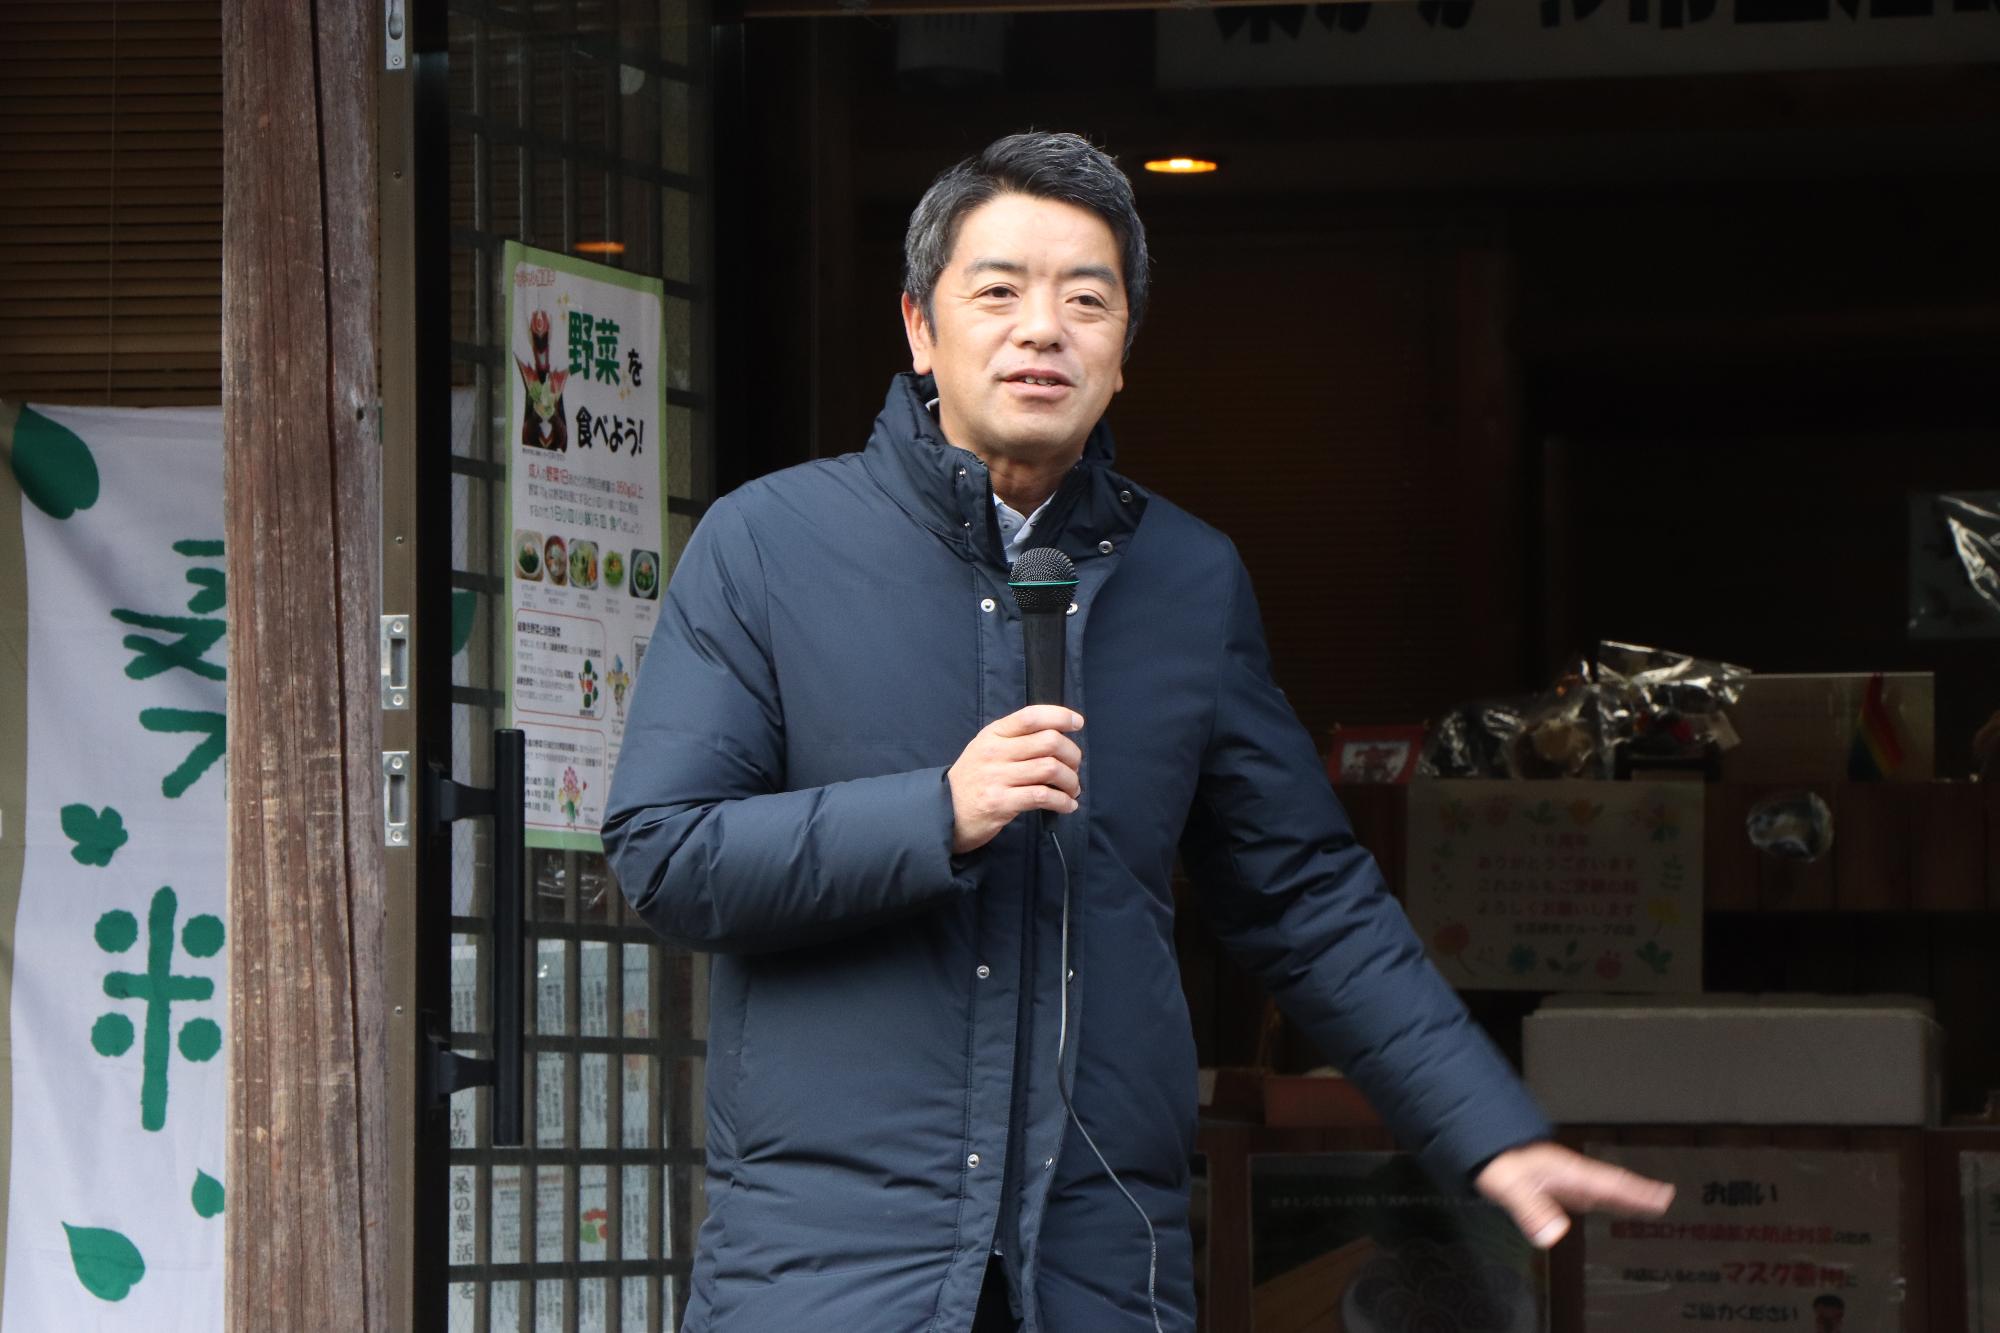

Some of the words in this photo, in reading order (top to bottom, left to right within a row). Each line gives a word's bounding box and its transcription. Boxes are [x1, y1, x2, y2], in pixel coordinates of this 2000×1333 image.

[567, 310, 643, 386] 野菜を
[575, 406, 644, 456] 食べよう!
[1702, 1179, 1779, 1206] お願い
[1681, 1302, 1799, 1322] ご協力ください
